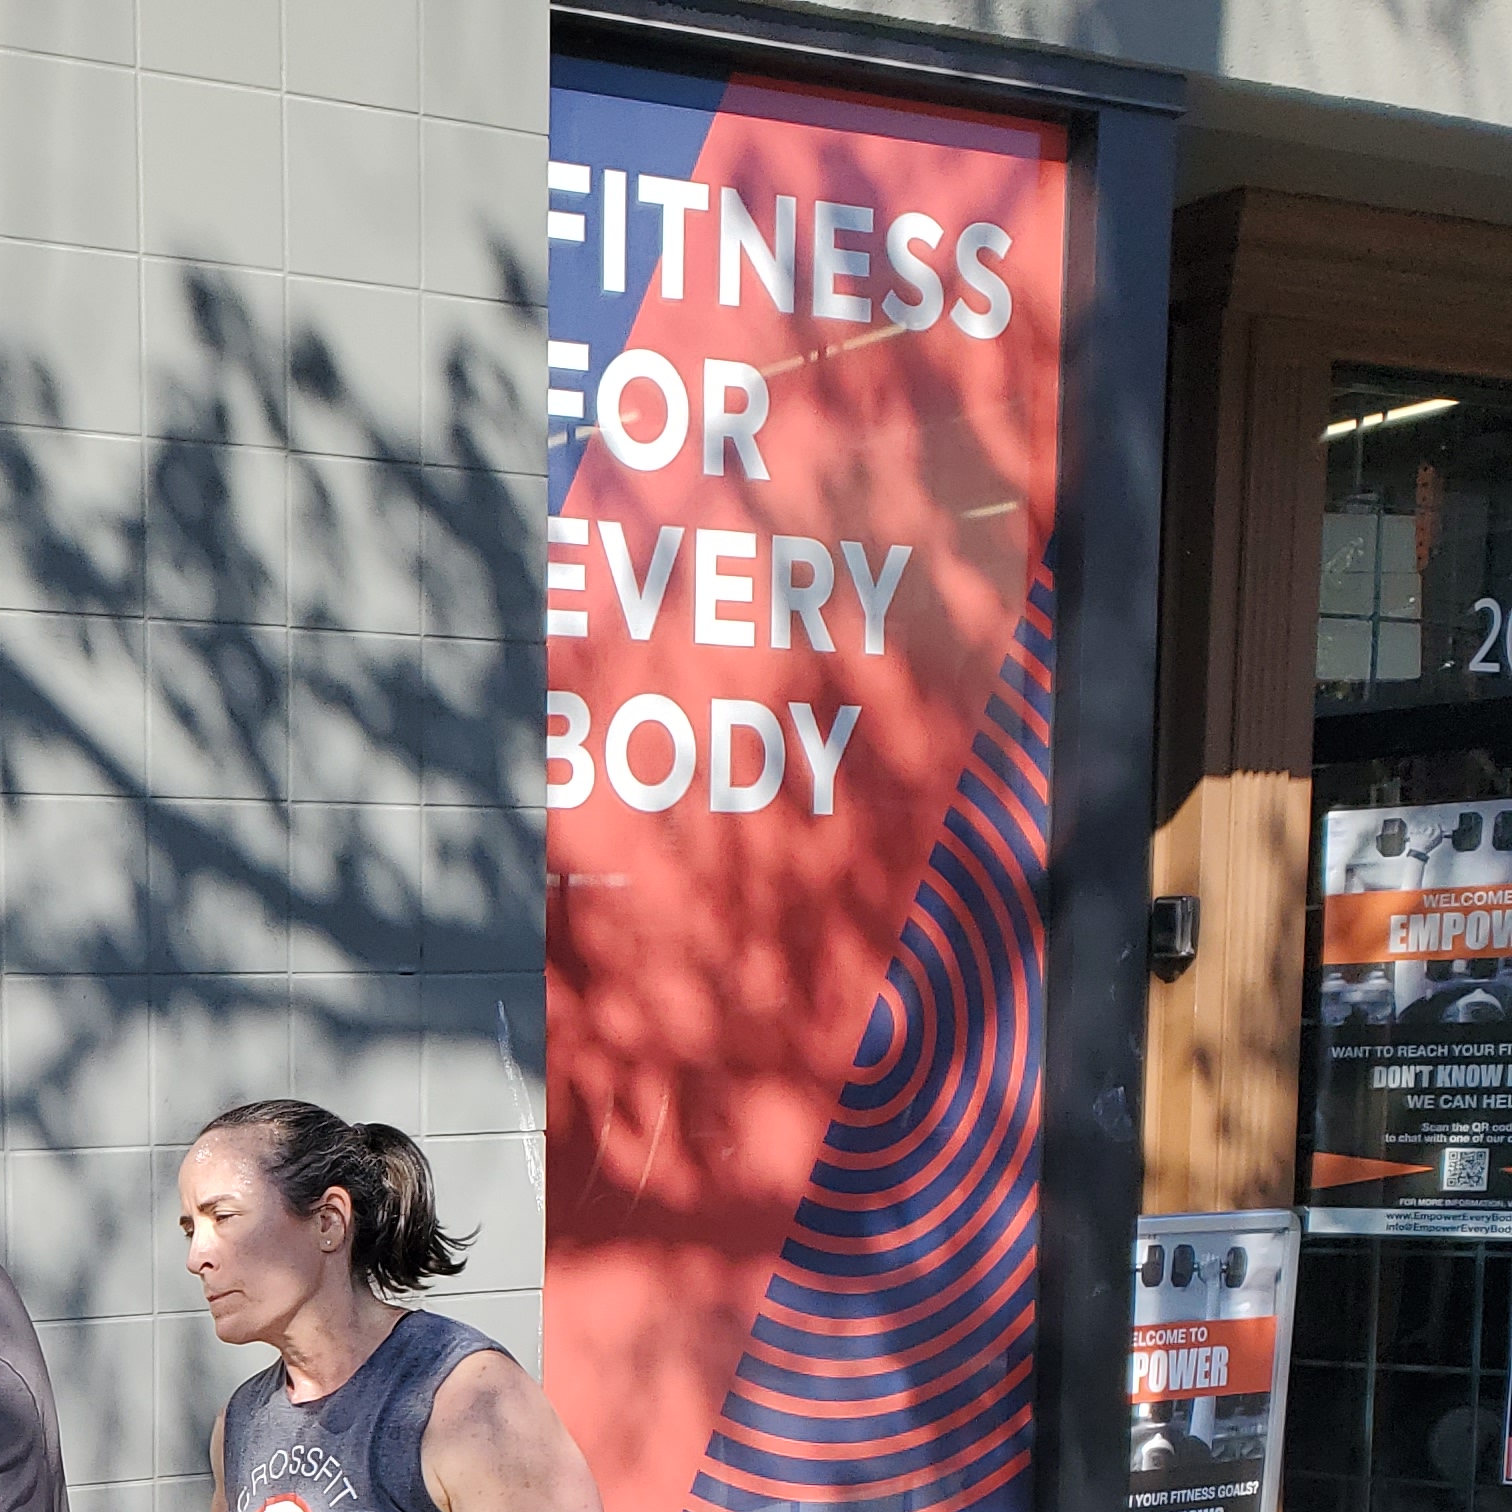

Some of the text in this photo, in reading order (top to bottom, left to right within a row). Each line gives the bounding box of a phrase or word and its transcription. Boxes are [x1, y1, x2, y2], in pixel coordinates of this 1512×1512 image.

[548, 161, 1013, 340] FITNESS
[548, 340, 772, 481] FOR
[547, 516, 914, 656] EVERY
[1469, 597, 1512, 673] 2
[547, 690, 863, 816] BODY
[1423, 889, 1512, 908] WELCOME
[1331, 1046, 1372, 1058] WANT
[1375, 1046, 1394, 1058] TO
[1397, 1045, 1448, 1058] REACH
[1452, 1044, 1495, 1057] YOUR
[1373, 1064, 1433, 1088] DON'T
[1436, 1063, 1504, 1088] KNOW
[1407, 1094, 1436, 1109] WE
[1439, 1094, 1477, 1109] CAN
[1385, 1133, 1396, 1143] to
[1398, 1133, 1422, 1143] chat
[1424, 1133, 1447, 1143] with
[1449, 1134, 1470, 1143] one
[1421, 1122, 1449, 1132] Scan
[1452, 1122, 1470, 1132] the
[1472, 1122, 1489, 1133] QR
[1189, 1326, 1208, 1343] TO
[1135, 1491, 1168, 1508] YOUR
[1170, 1486, 1215, 1504] FITNESS
[1217, 1480, 1259, 1499] GOALS?
